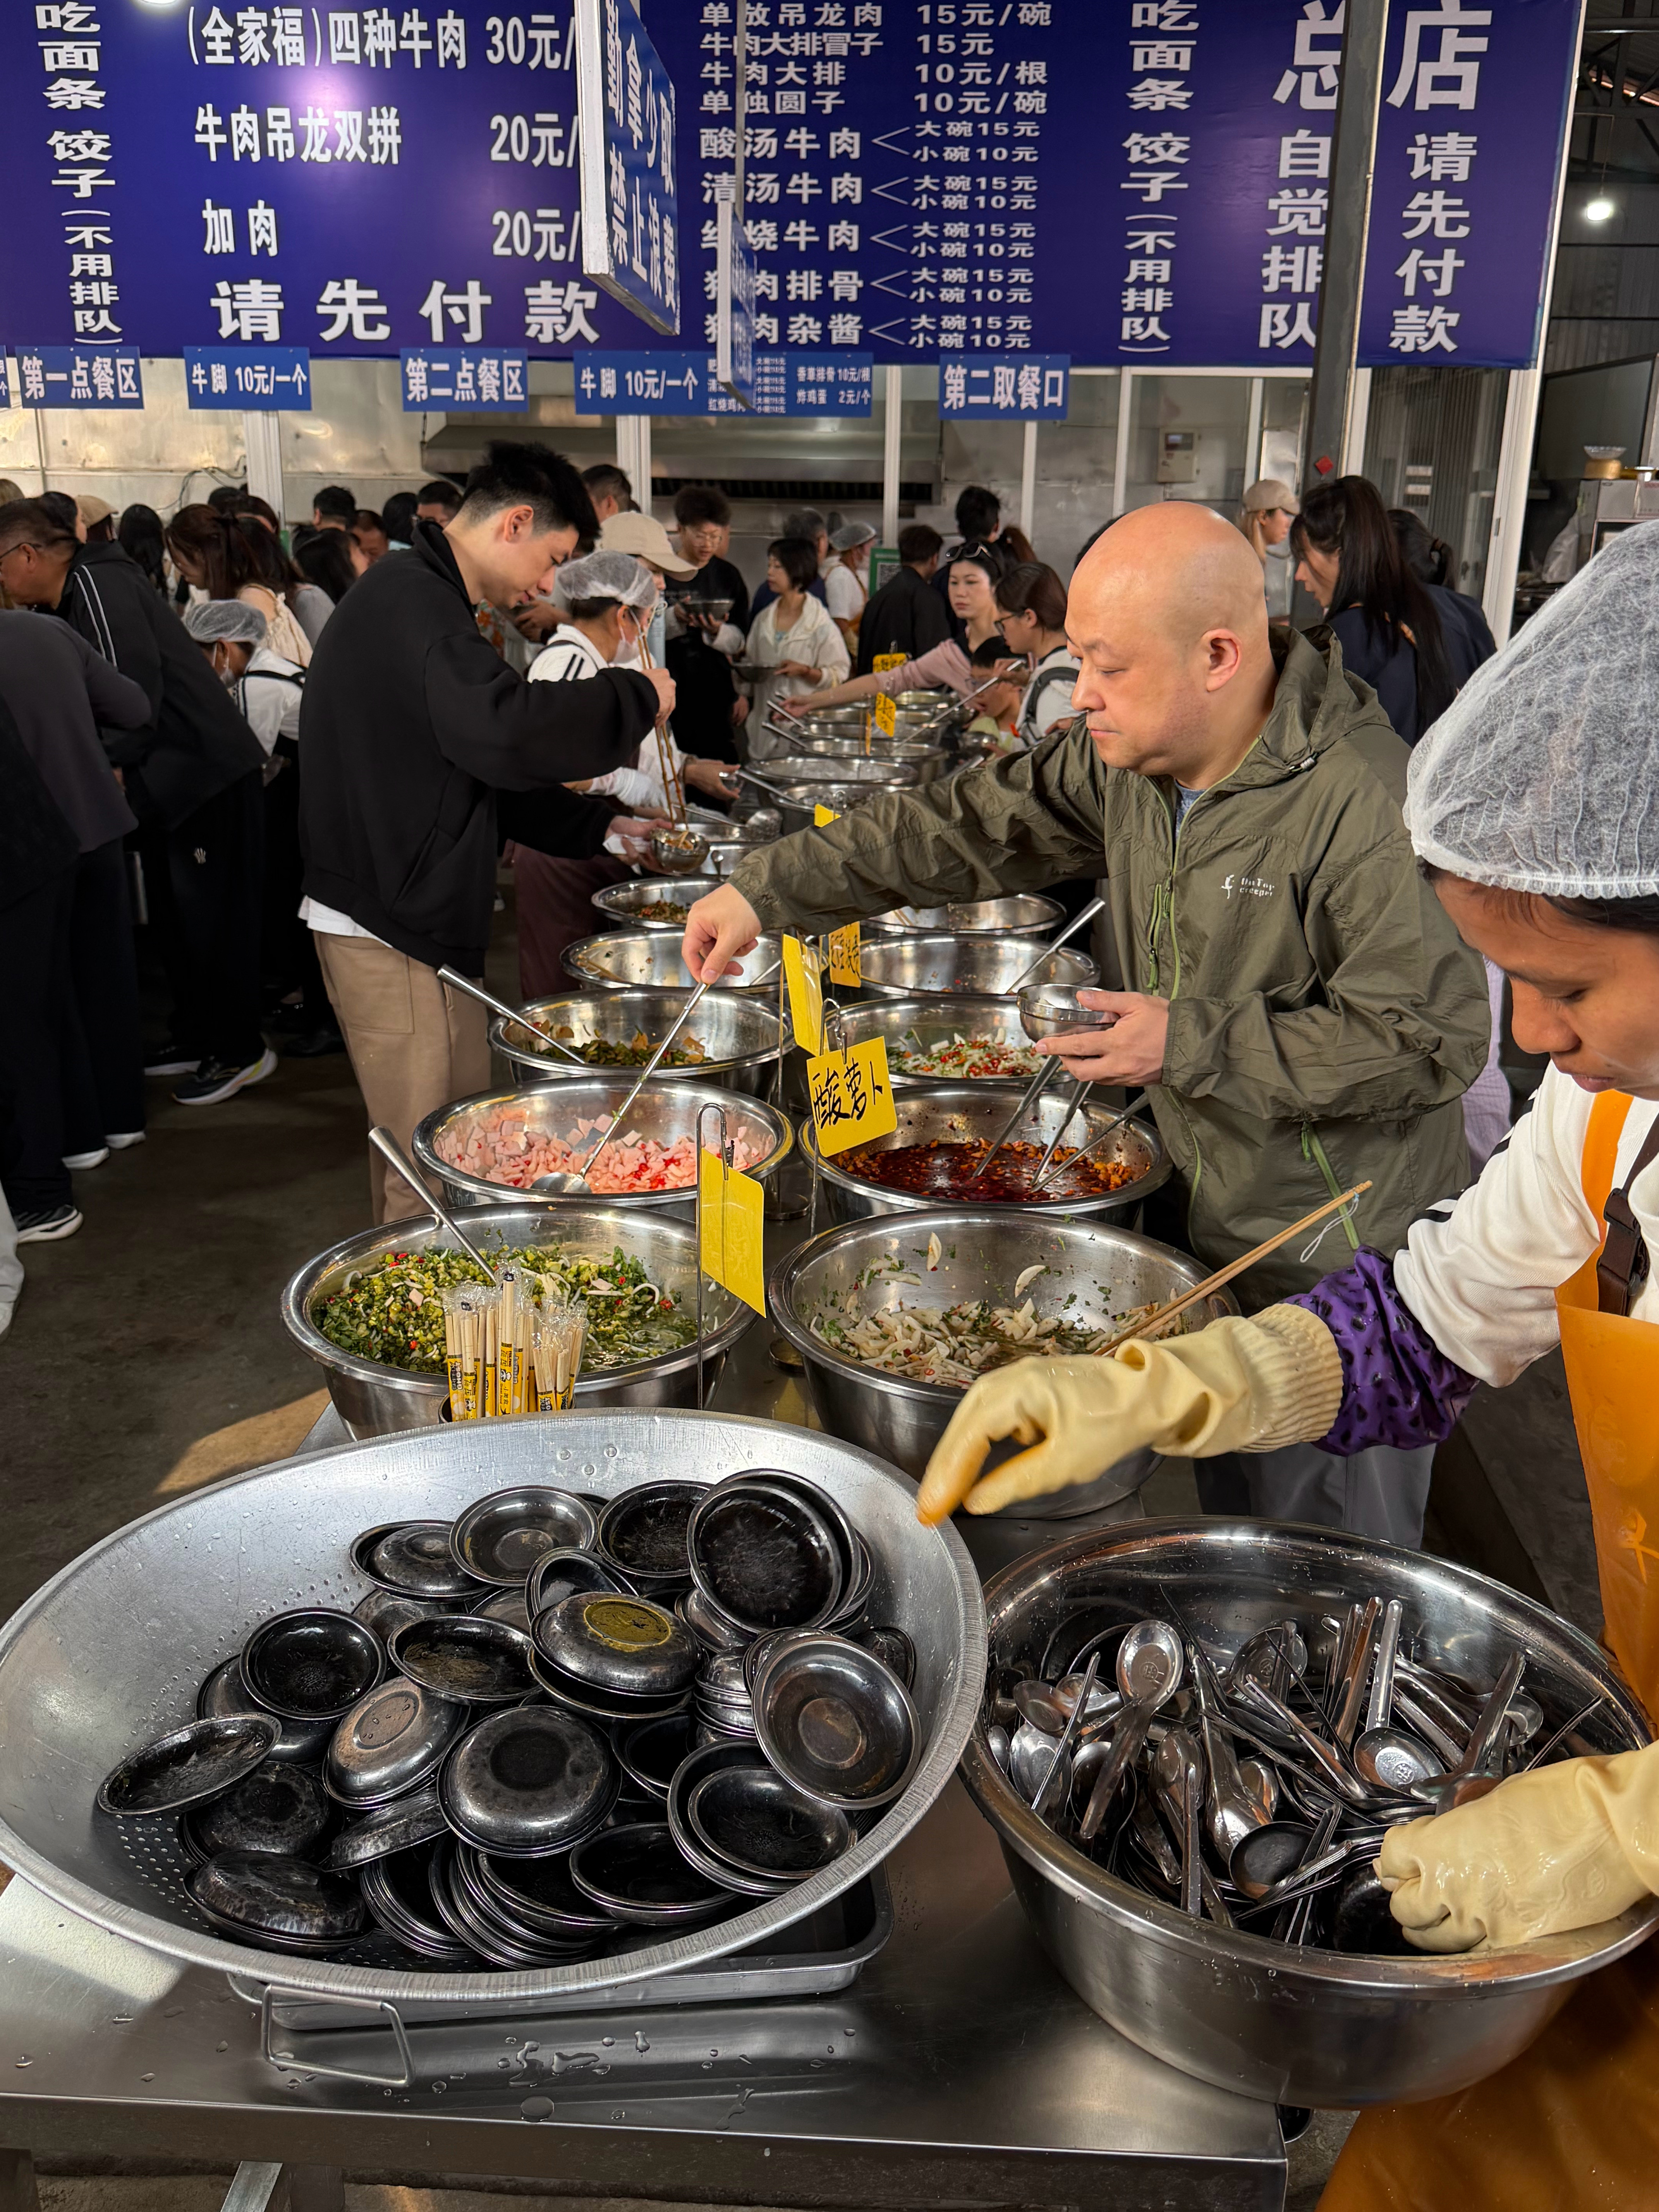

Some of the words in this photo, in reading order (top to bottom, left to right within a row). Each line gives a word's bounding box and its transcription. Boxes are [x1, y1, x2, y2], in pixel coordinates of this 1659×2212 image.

[700, 2, 881, 27] 单放吊龙肉
[918, 2, 1051, 26] 15元/碗
[188, 5, 467, 69] (全家福)四种牛肉
[918, 33, 993, 55] 15元
[36, 1, 106, 109] 吃面条
[1127, 0, 1199, 110] 吃面条
[701, 61, 845, 85] 牛肉大排
[916, 61, 1047, 84] 10元/根
[699, 90, 846, 115] 单独圆子
[915, 90, 1047, 113] 10元/碗
[194, 103, 402, 165] 牛肉吊龙双拼
[699, 126, 861, 160] 酸汤牛肉
[916, 121, 1039, 137] 大碗15元
[914, 146, 1038, 161] 小碗10元
[701, 172, 863, 205] 清汤牛肉
[915, 175, 1037, 191] 大碗15元
[912, 194, 1036, 210] 小碗10元
[46, 130, 123, 344] 饺子(不用排队)
[202, 199, 278, 256] 加肉
[609, 142, 676, 314] 禁止浪费
[914, 222, 1035, 238] 大碗15元
[1119, 132, 1190, 352] 饺子(不用排队)
[1259, 129, 1332, 349] 自觉排队
[1389, 132, 1477, 352] 请先付款
[911, 242, 1034, 258] 小碗10元
[913, 267, 1033, 283] 大碗15元
[210, 279, 599, 343] 请先付款
[910, 287, 1032, 303] 小碗10元
[911, 314, 1032, 330] 大碗15元
[909, 333, 1030, 348] 小碗10元
[22, 355, 140, 400] 第一点餐区
[235, 363, 307, 395] 10元/一个
[405, 357, 524, 402] 第二点餐区
[625, 368, 698, 400] 10元/一个
[943, 364, 1063, 410] 第二取餐口
[838, 390, 870, 404] 2元/个
[812, 1057, 883, 1129] 酸萝卜
